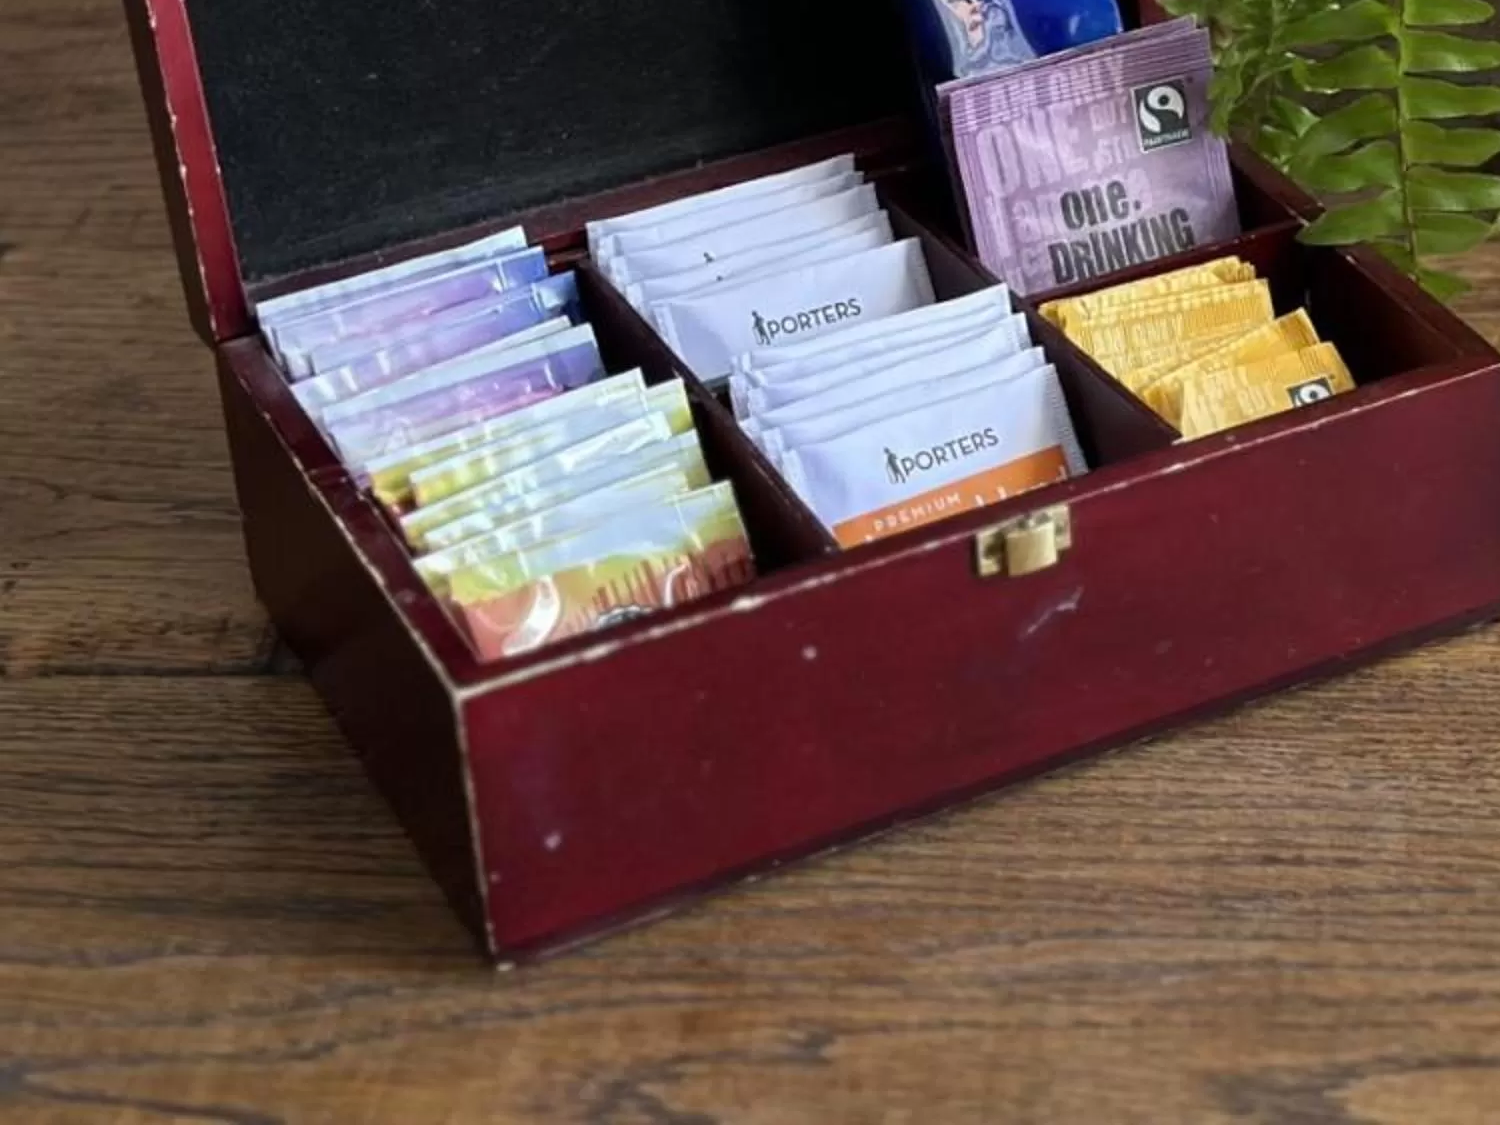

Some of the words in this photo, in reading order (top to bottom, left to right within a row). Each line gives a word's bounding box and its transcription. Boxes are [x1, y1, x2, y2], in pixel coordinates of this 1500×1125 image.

[1047, 206, 1196, 285] DRINKING
[766, 297, 862, 340] PORTERS
[901, 427, 1000, 477] PORTERS
[872, 491, 962, 532] PREMIUM
